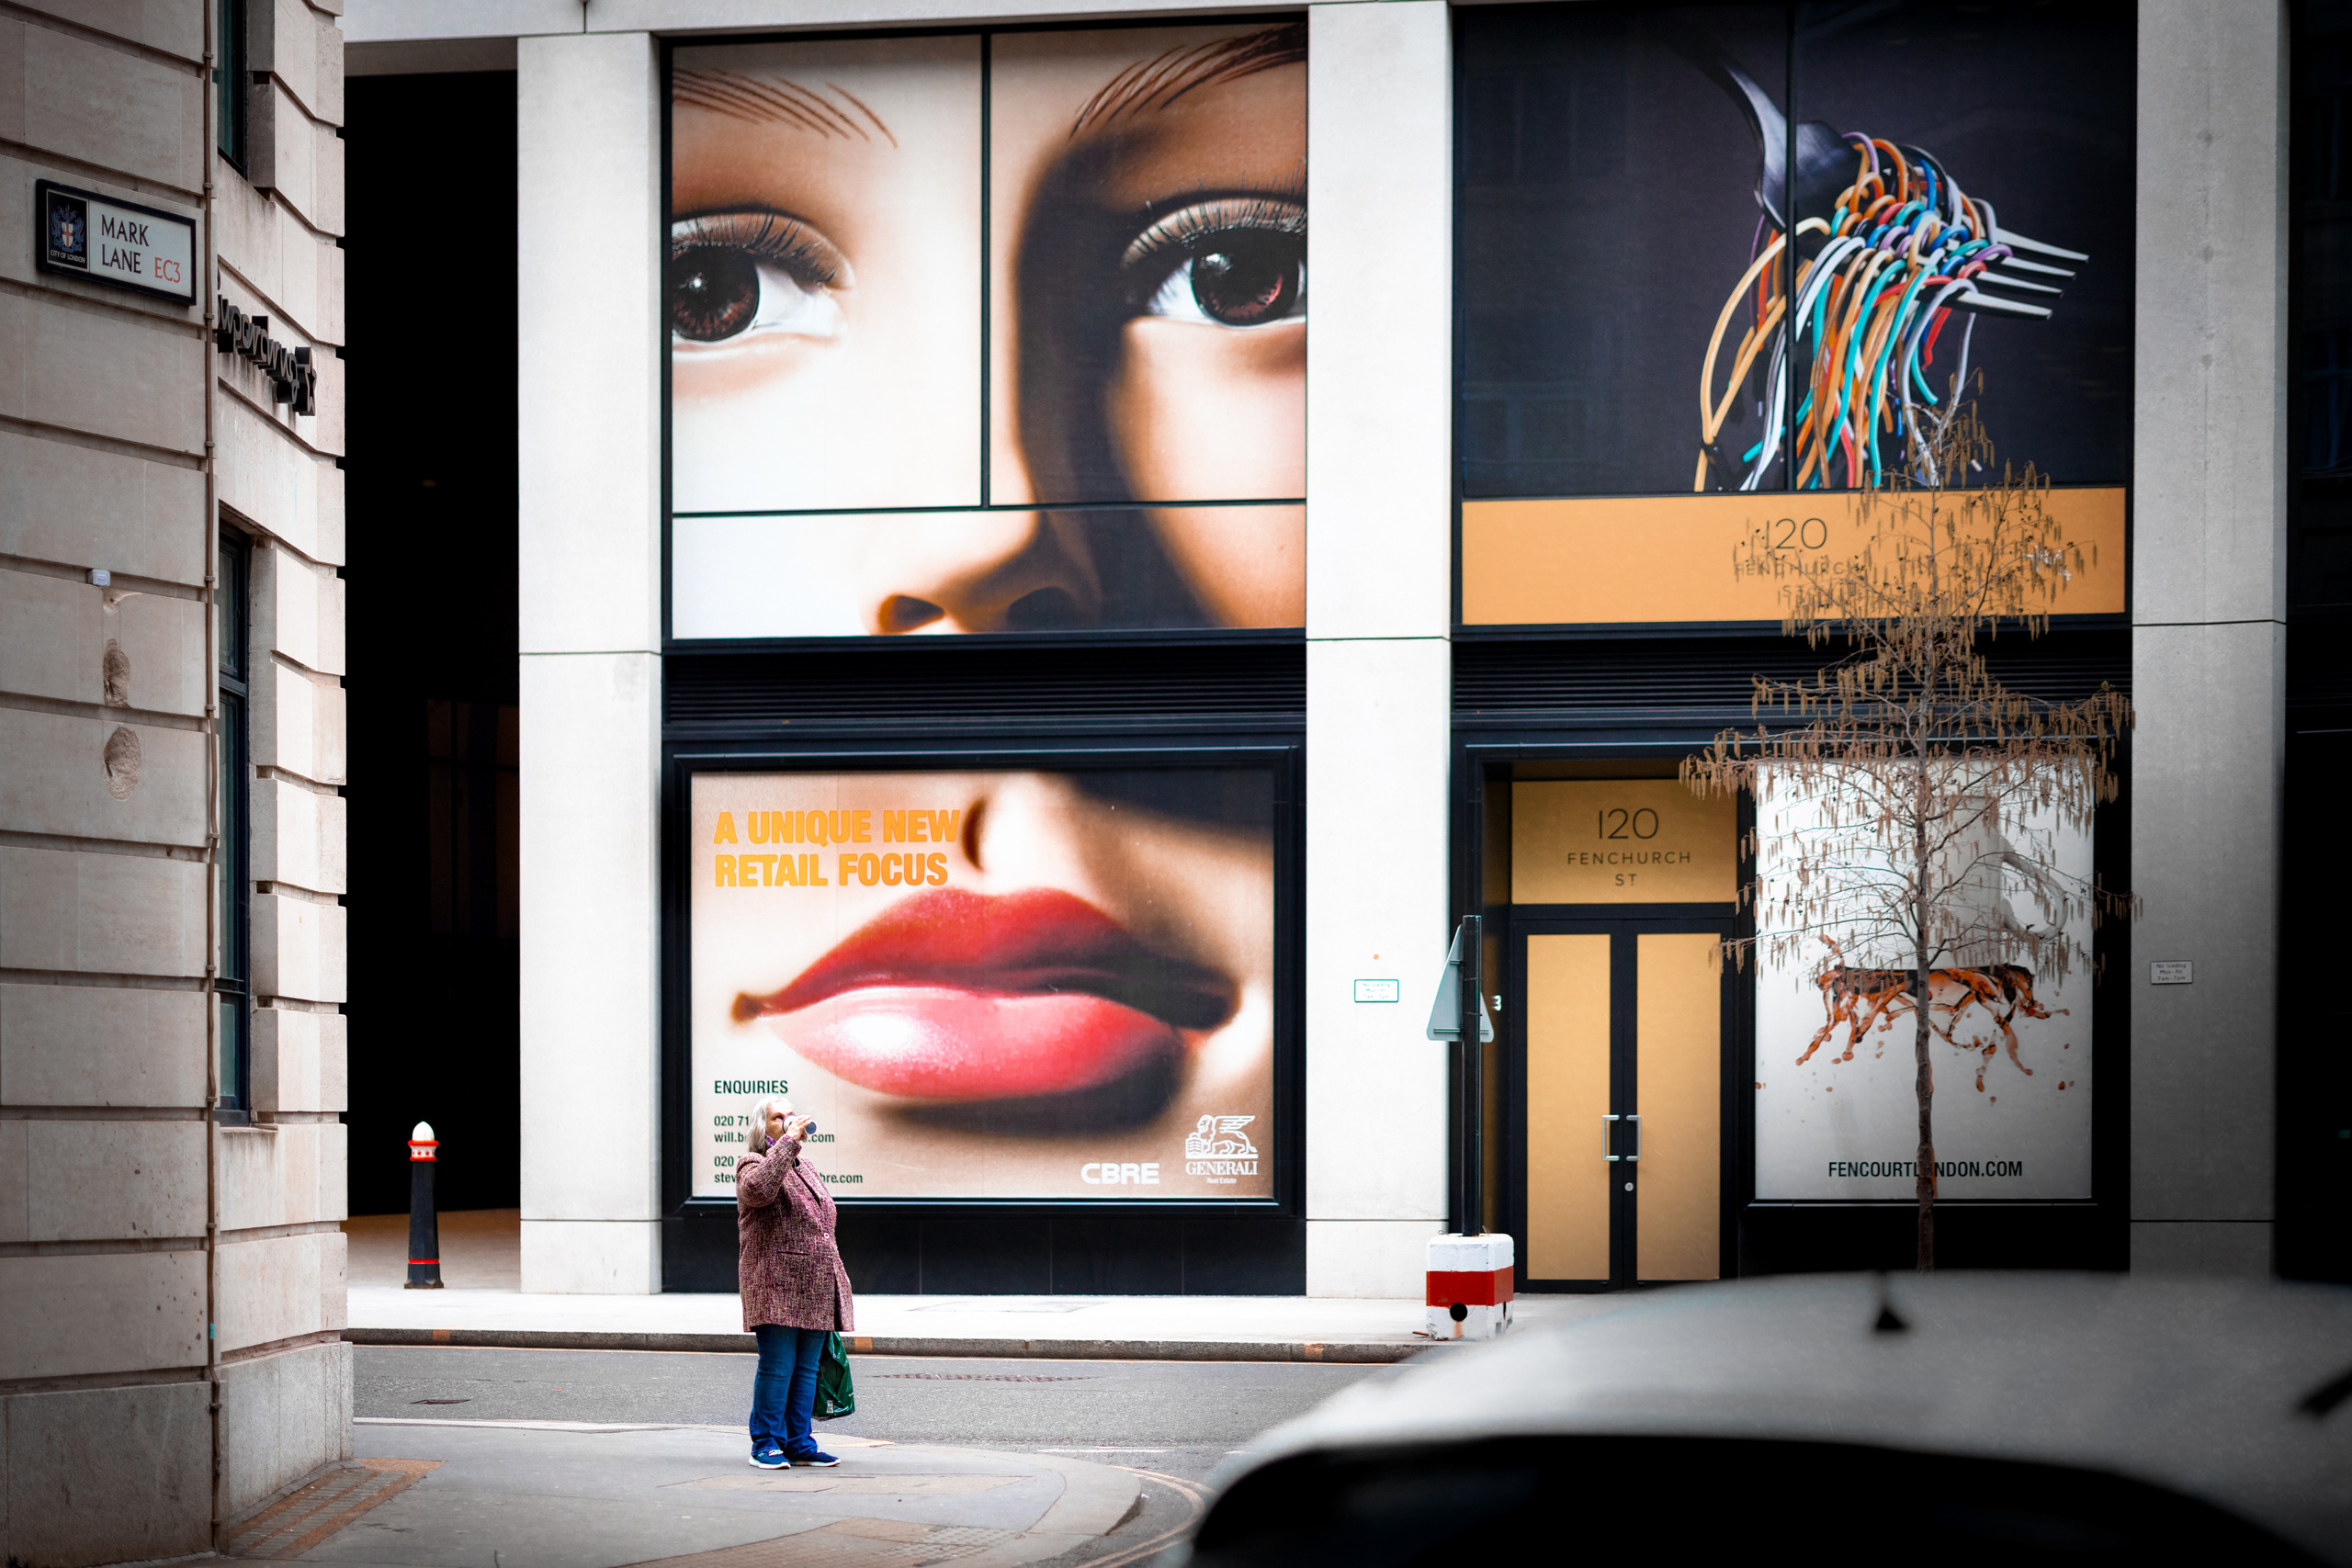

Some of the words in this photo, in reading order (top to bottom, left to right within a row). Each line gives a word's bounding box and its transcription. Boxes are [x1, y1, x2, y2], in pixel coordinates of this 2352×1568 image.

[101, 214, 149, 247] MARK
[50, 249, 61, 257] CITY
[67, 254, 85, 264] LONDON
[101, 243, 141, 274] LANE
[154, 256, 181, 284] EC3
[218, 294, 300, 404] uperdrug
[1765, 518, 1827, 549] 120
[713, 811, 738, 844] A
[748, 809, 872, 847] UNIQUE
[883, 809, 960, 843] NEW
[1599, 808, 1659, 840] 120
[715, 853, 828, 886] RETAIL
[839, 852, 948, 886] FOCUS
[1567, 852, 1690, 865] FENCHURCH
[714, 1079, 789, 1095] ENQUIRIES
[714, 1115, 734, 1126] 020
[714, 1156, 734, 1167] 020
[1185, 1161, 1258, 1176] GENERALI
[1828, 1160, 2023, 1178] FENCOURTLNDON.COM
[1080, 1162, 1160, 1185] CBRE
